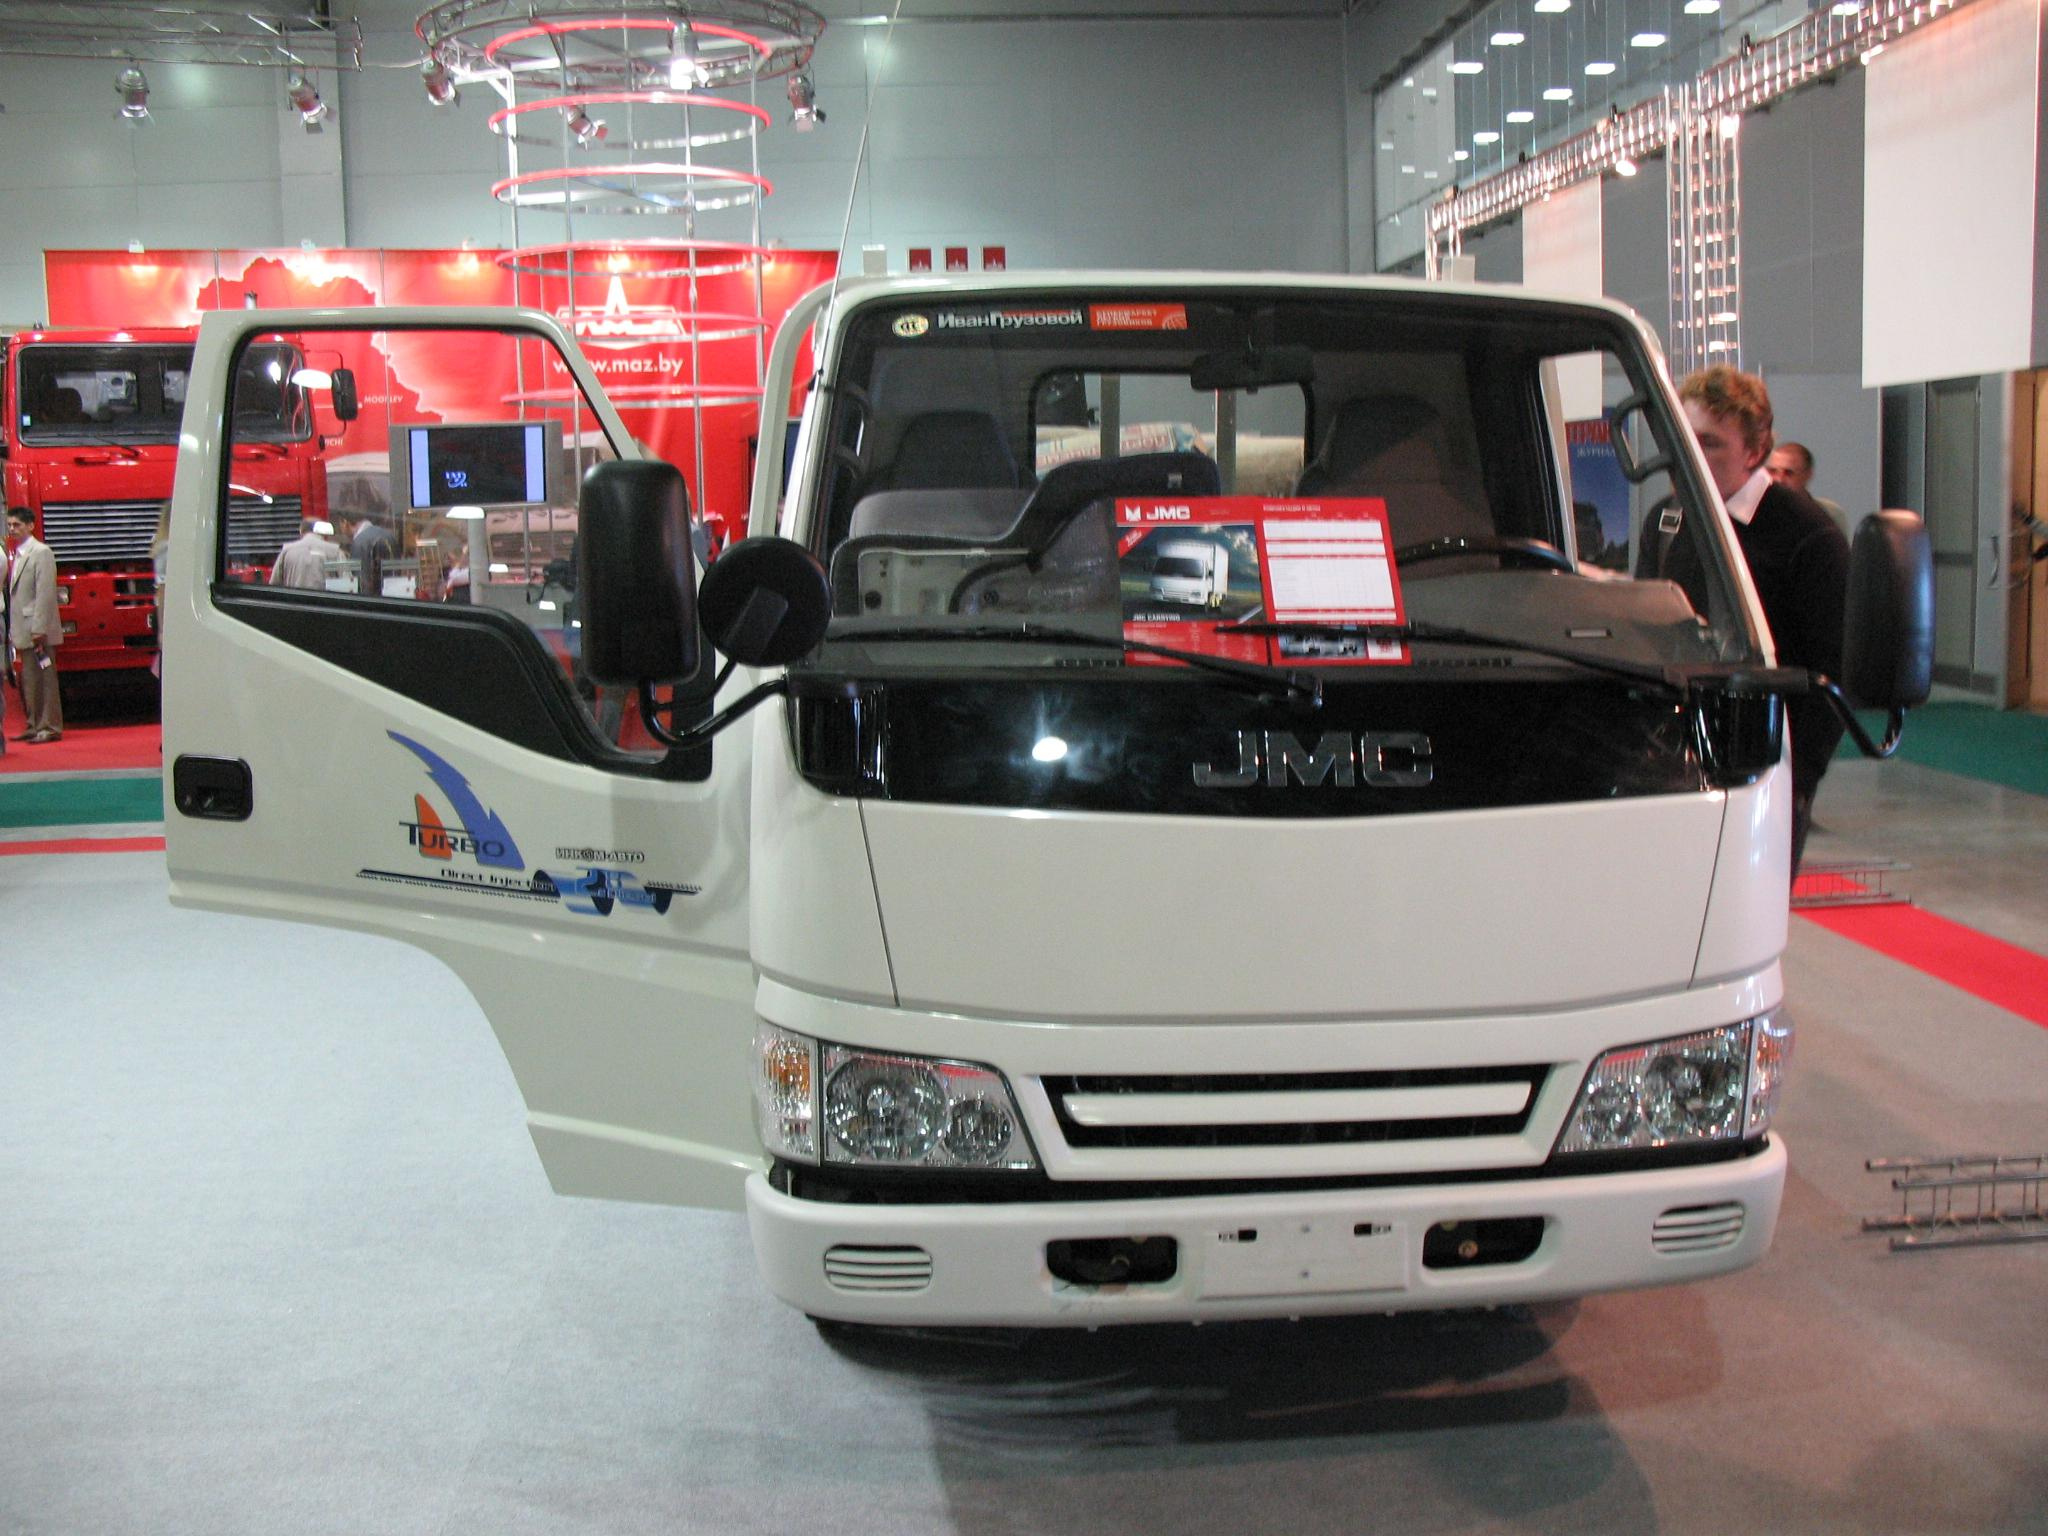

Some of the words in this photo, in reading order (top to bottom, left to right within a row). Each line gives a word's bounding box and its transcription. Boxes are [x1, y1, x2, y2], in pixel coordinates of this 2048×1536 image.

[937, 311, 1083, 329] ИванГрузовой
[553, 352, 683, 377] ww.maz.by
[1146, 505, 1190, 520] JMC
[1193, 730, 1433, 787] JMC
[440, 868, 483, 882] Direct
